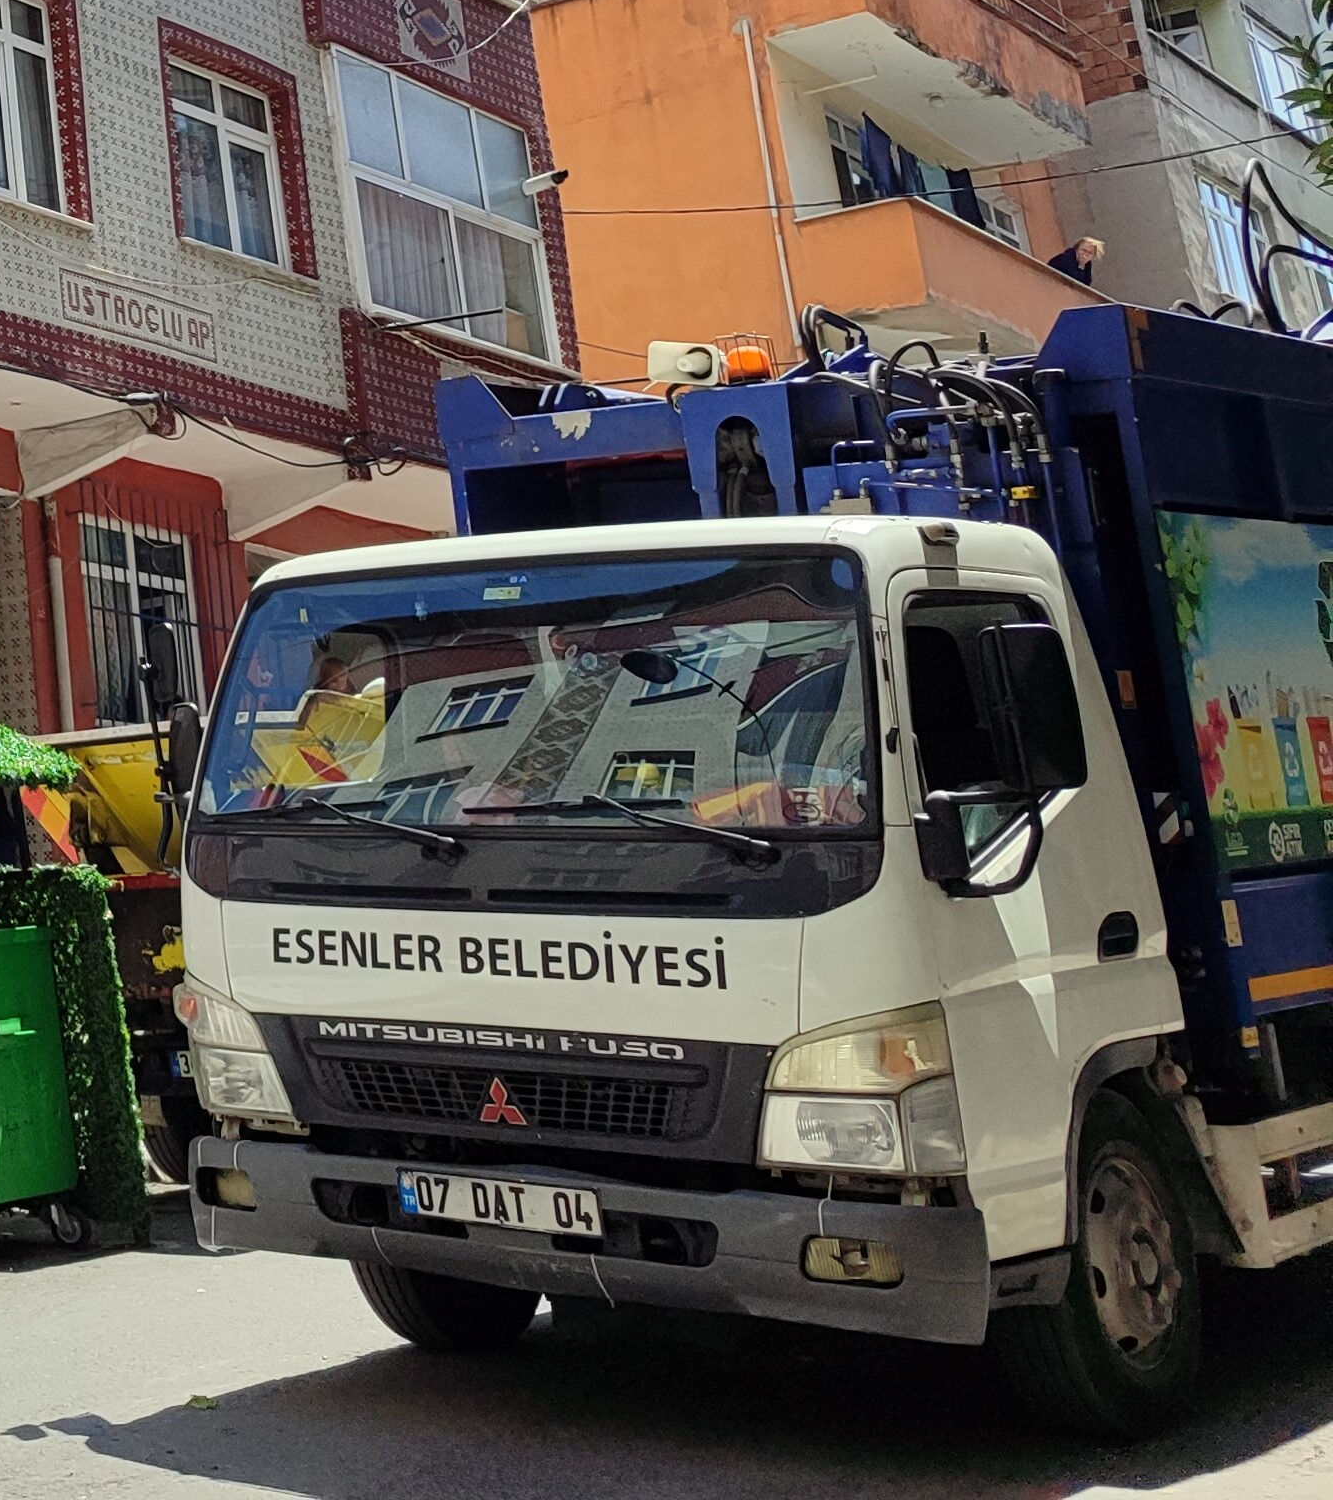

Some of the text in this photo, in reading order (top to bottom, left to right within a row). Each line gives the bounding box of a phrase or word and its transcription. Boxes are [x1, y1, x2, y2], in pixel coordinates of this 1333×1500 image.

[186, 317, 210, 349] AP
[272, 927, 729, 990] ESENLER BELEDİYESİ
[318, 1021, 545, 1050] MITSUBISHI
[416, 1175, 450, 1214] 07
[471, 1181, 526, 1224] DAT
[552, 1191, 593, 1231] 04
